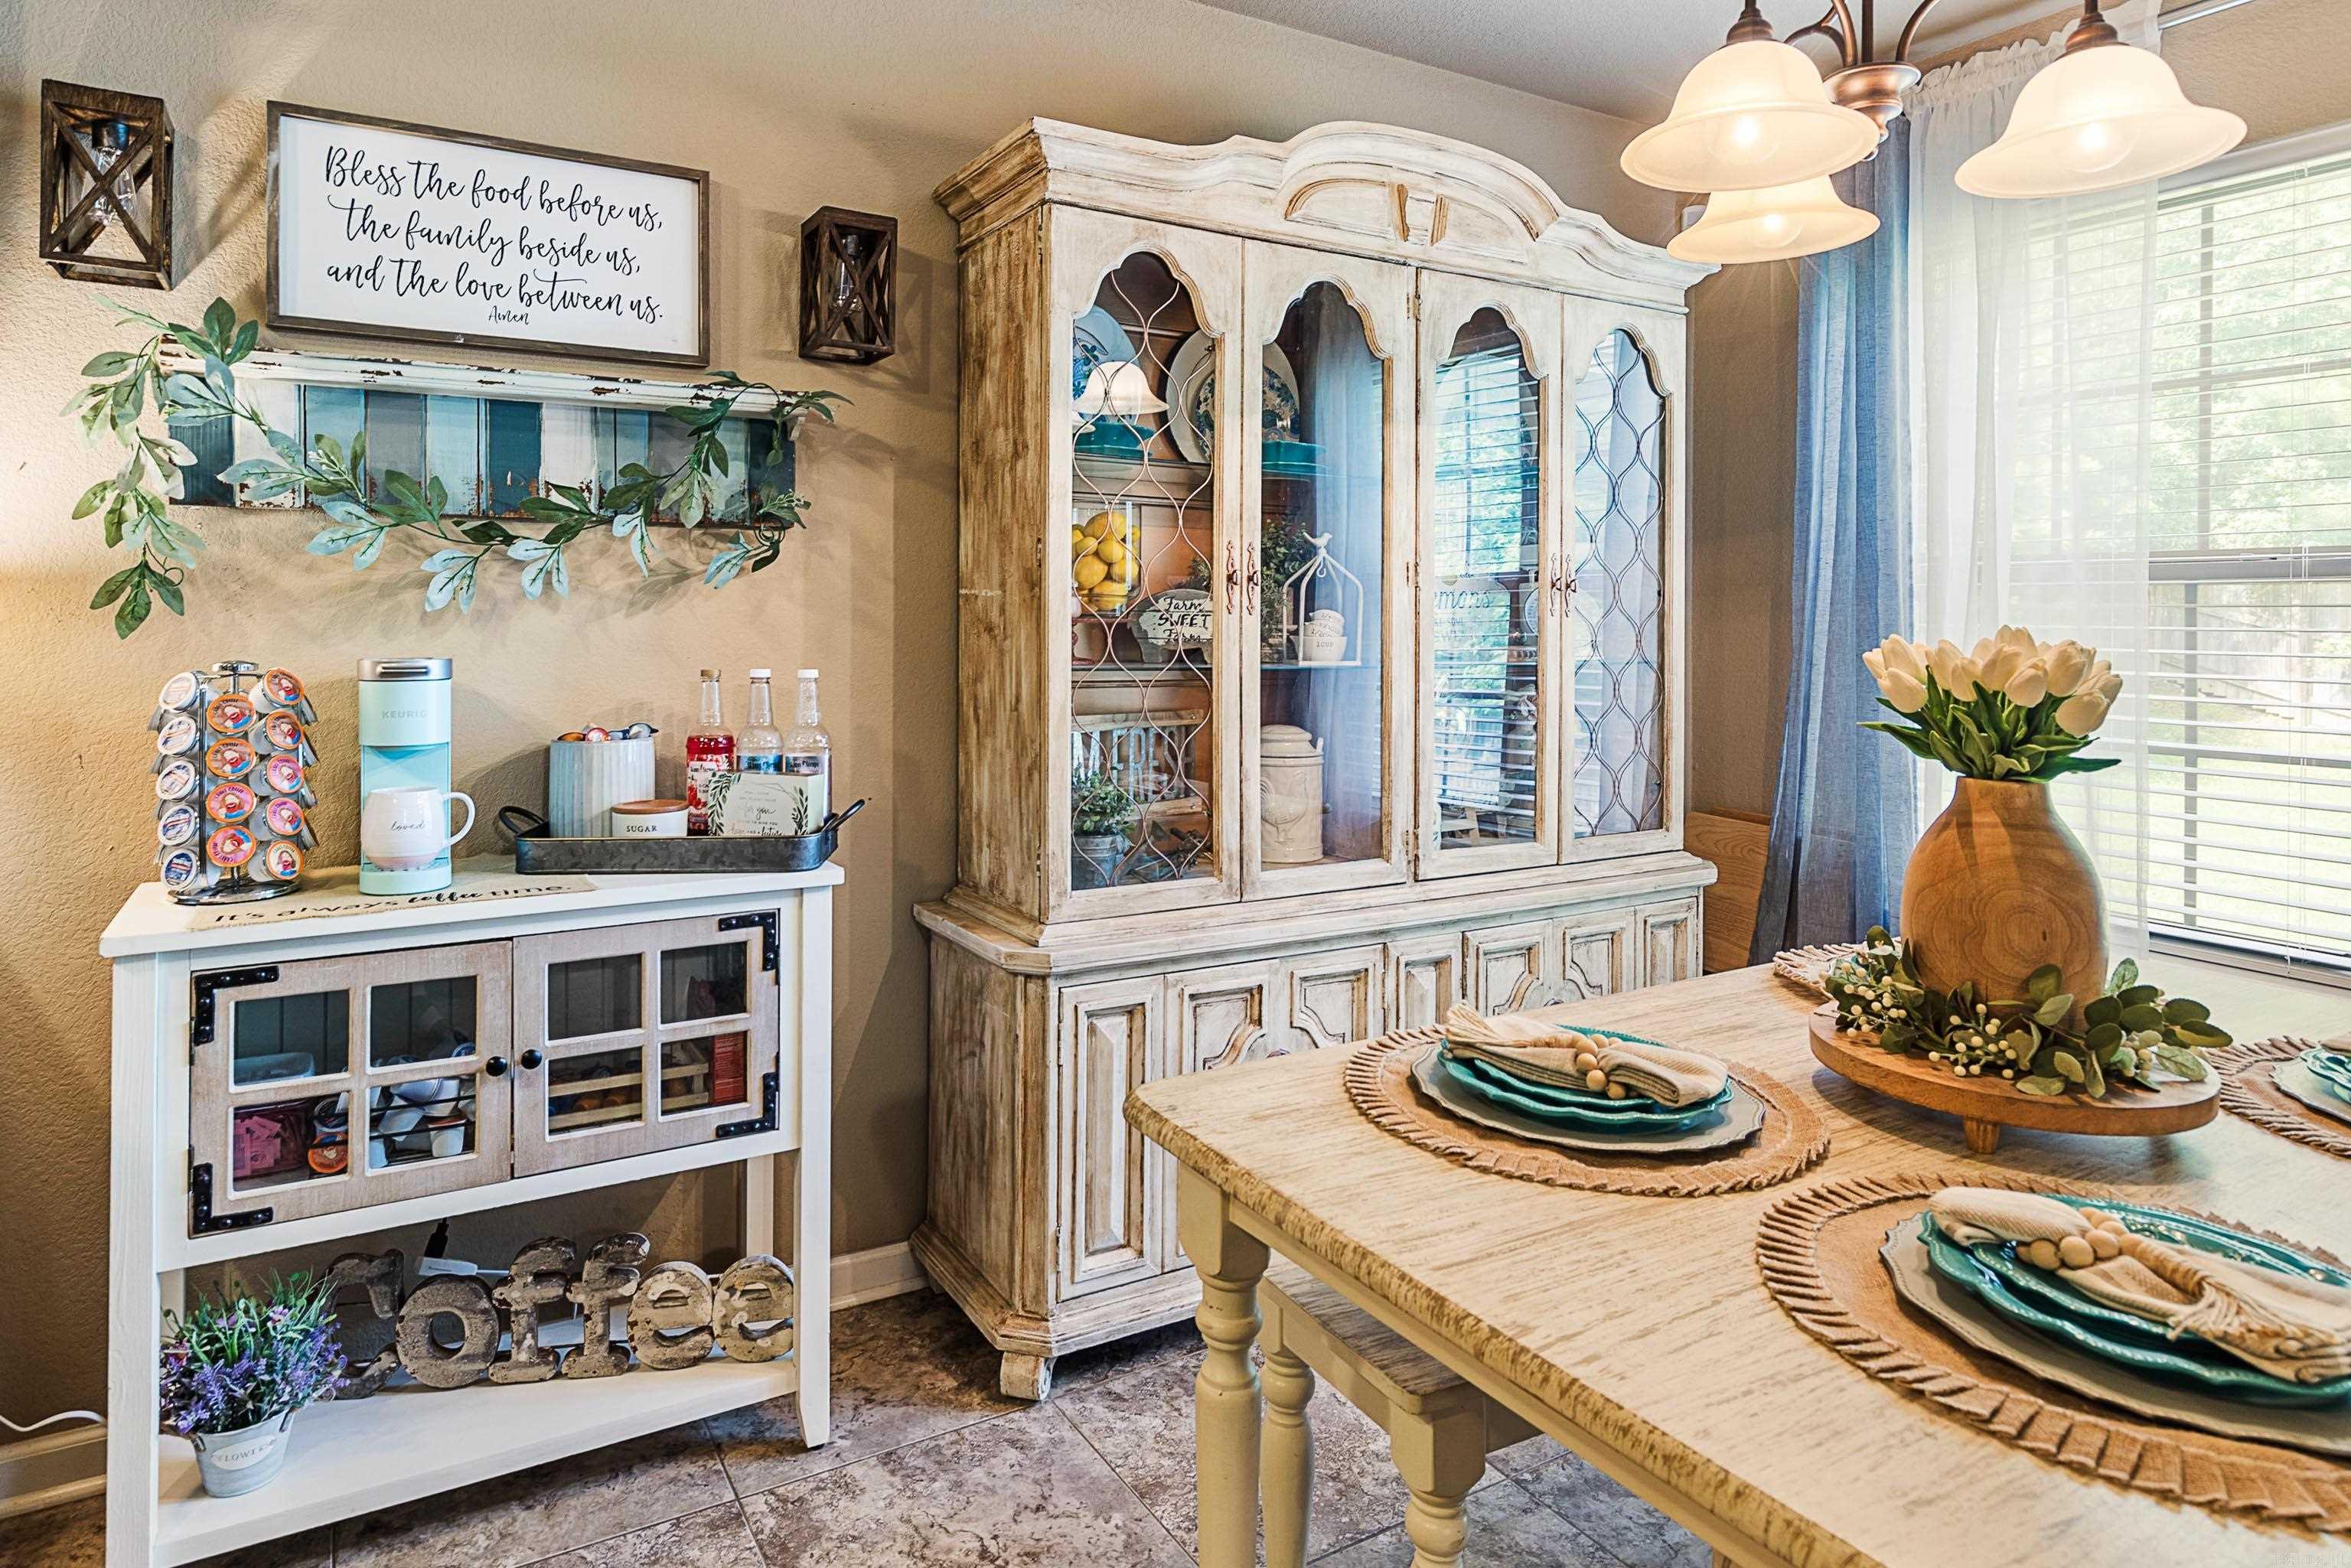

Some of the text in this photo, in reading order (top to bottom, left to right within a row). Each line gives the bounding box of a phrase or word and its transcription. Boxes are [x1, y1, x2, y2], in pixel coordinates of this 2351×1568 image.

[325, 145, 406, 197] Bless
[471, 169, 533, 211] food
[539, 180, 624, 228] before
[628, 202, 663, 232] us,
[328, 194, 641, 275] the family beside us,
[327, 255, 385, 292] and
[455, 261, 513, 302] love
[519, 268, 624, 317] between
[630, 295, 664, 324] us.
[488, 305, 530, 325] Amen
[1163, 596, 1205, 611] Farm
[1157, 613, 1212, 630] SWEET
[382, 709, 428, 719] KEURIG
[391, 820, 426, 831] loved
[215, 911, 264, 922] It's
[277, 901, 398, 917] always
[408, 891, 484, 903] coffee
